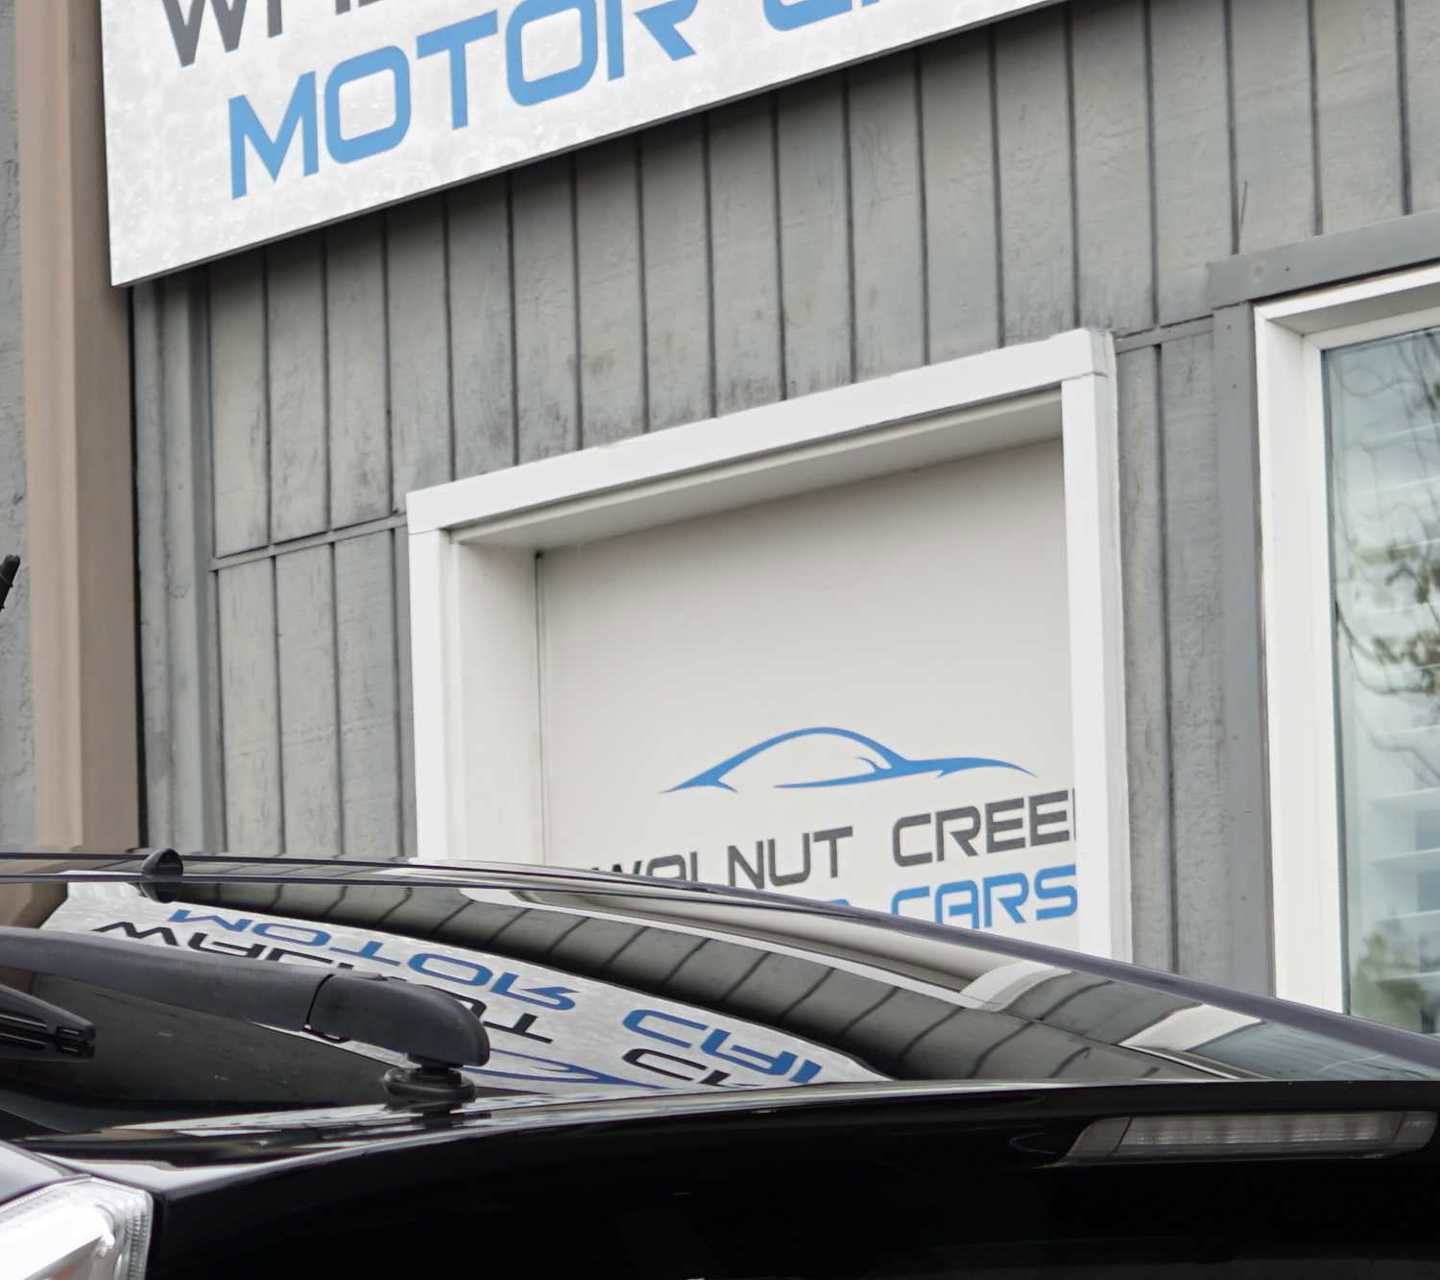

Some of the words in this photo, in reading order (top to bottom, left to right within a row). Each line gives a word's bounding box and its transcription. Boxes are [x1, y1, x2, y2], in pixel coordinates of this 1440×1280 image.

[228, 0, 697, 200] MOTOR
[591, 825, 854, 890] NUT
[892, 788, 1077, 867] CREE
[890, 864, 1078, 929] CARS
